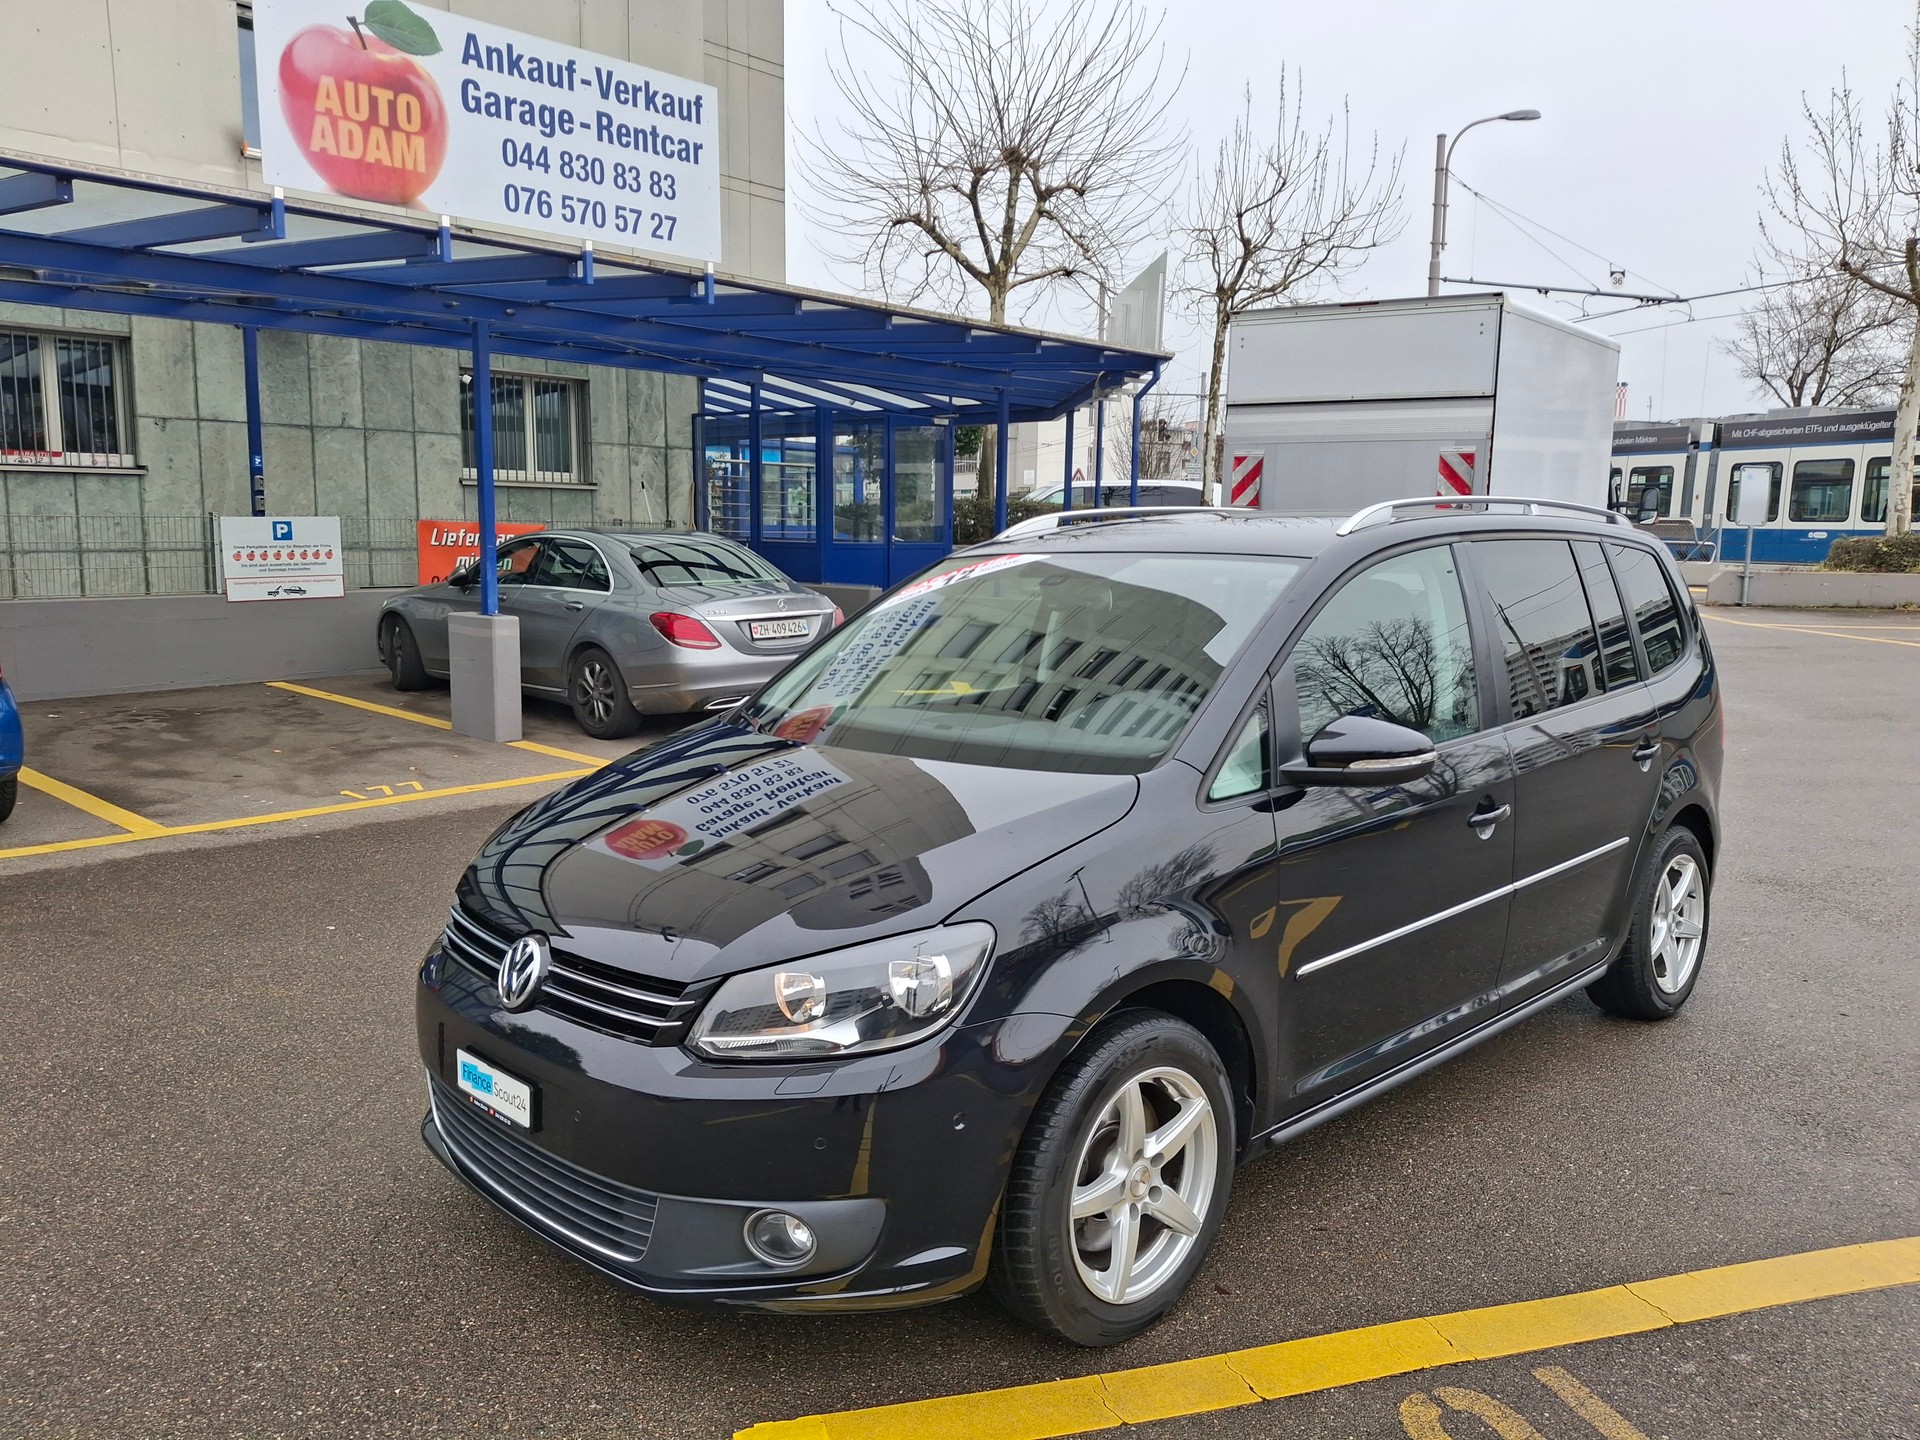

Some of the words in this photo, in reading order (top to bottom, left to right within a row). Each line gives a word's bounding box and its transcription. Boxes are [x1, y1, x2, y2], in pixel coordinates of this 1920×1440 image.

[314, 74, 422, 133] AUTO
[309, 114, 427, 173] ADAM
[502, 137, 552, 175] 044
[559, 151, 605, 184] 830
[613, 162, 642, 193] 83
[650, 171, 677, 201] 83
[503, 183, 552, 219] 076
[561, 194, 607, 229] 570
[614, 206, 643, 236] 57
[650, 213, 678, 242] 27
[1612, 276, 1623, 285] 36
[1731, 429, 1742, 438] Mit
[1743, 426, 1804, 438] CHF-abgesicherten
[1805, 424, 1822, 434] ETFs
[1823, 423, 1838, 432] und
[1839, 420, 1892, 433] ausgeklügelter
[1612, 437, 1634, 446] globalen
[1635, 435, 1658, 444] Märkten
[276, 523, 289, 539] P
[340, 780, 424, 800] 177
